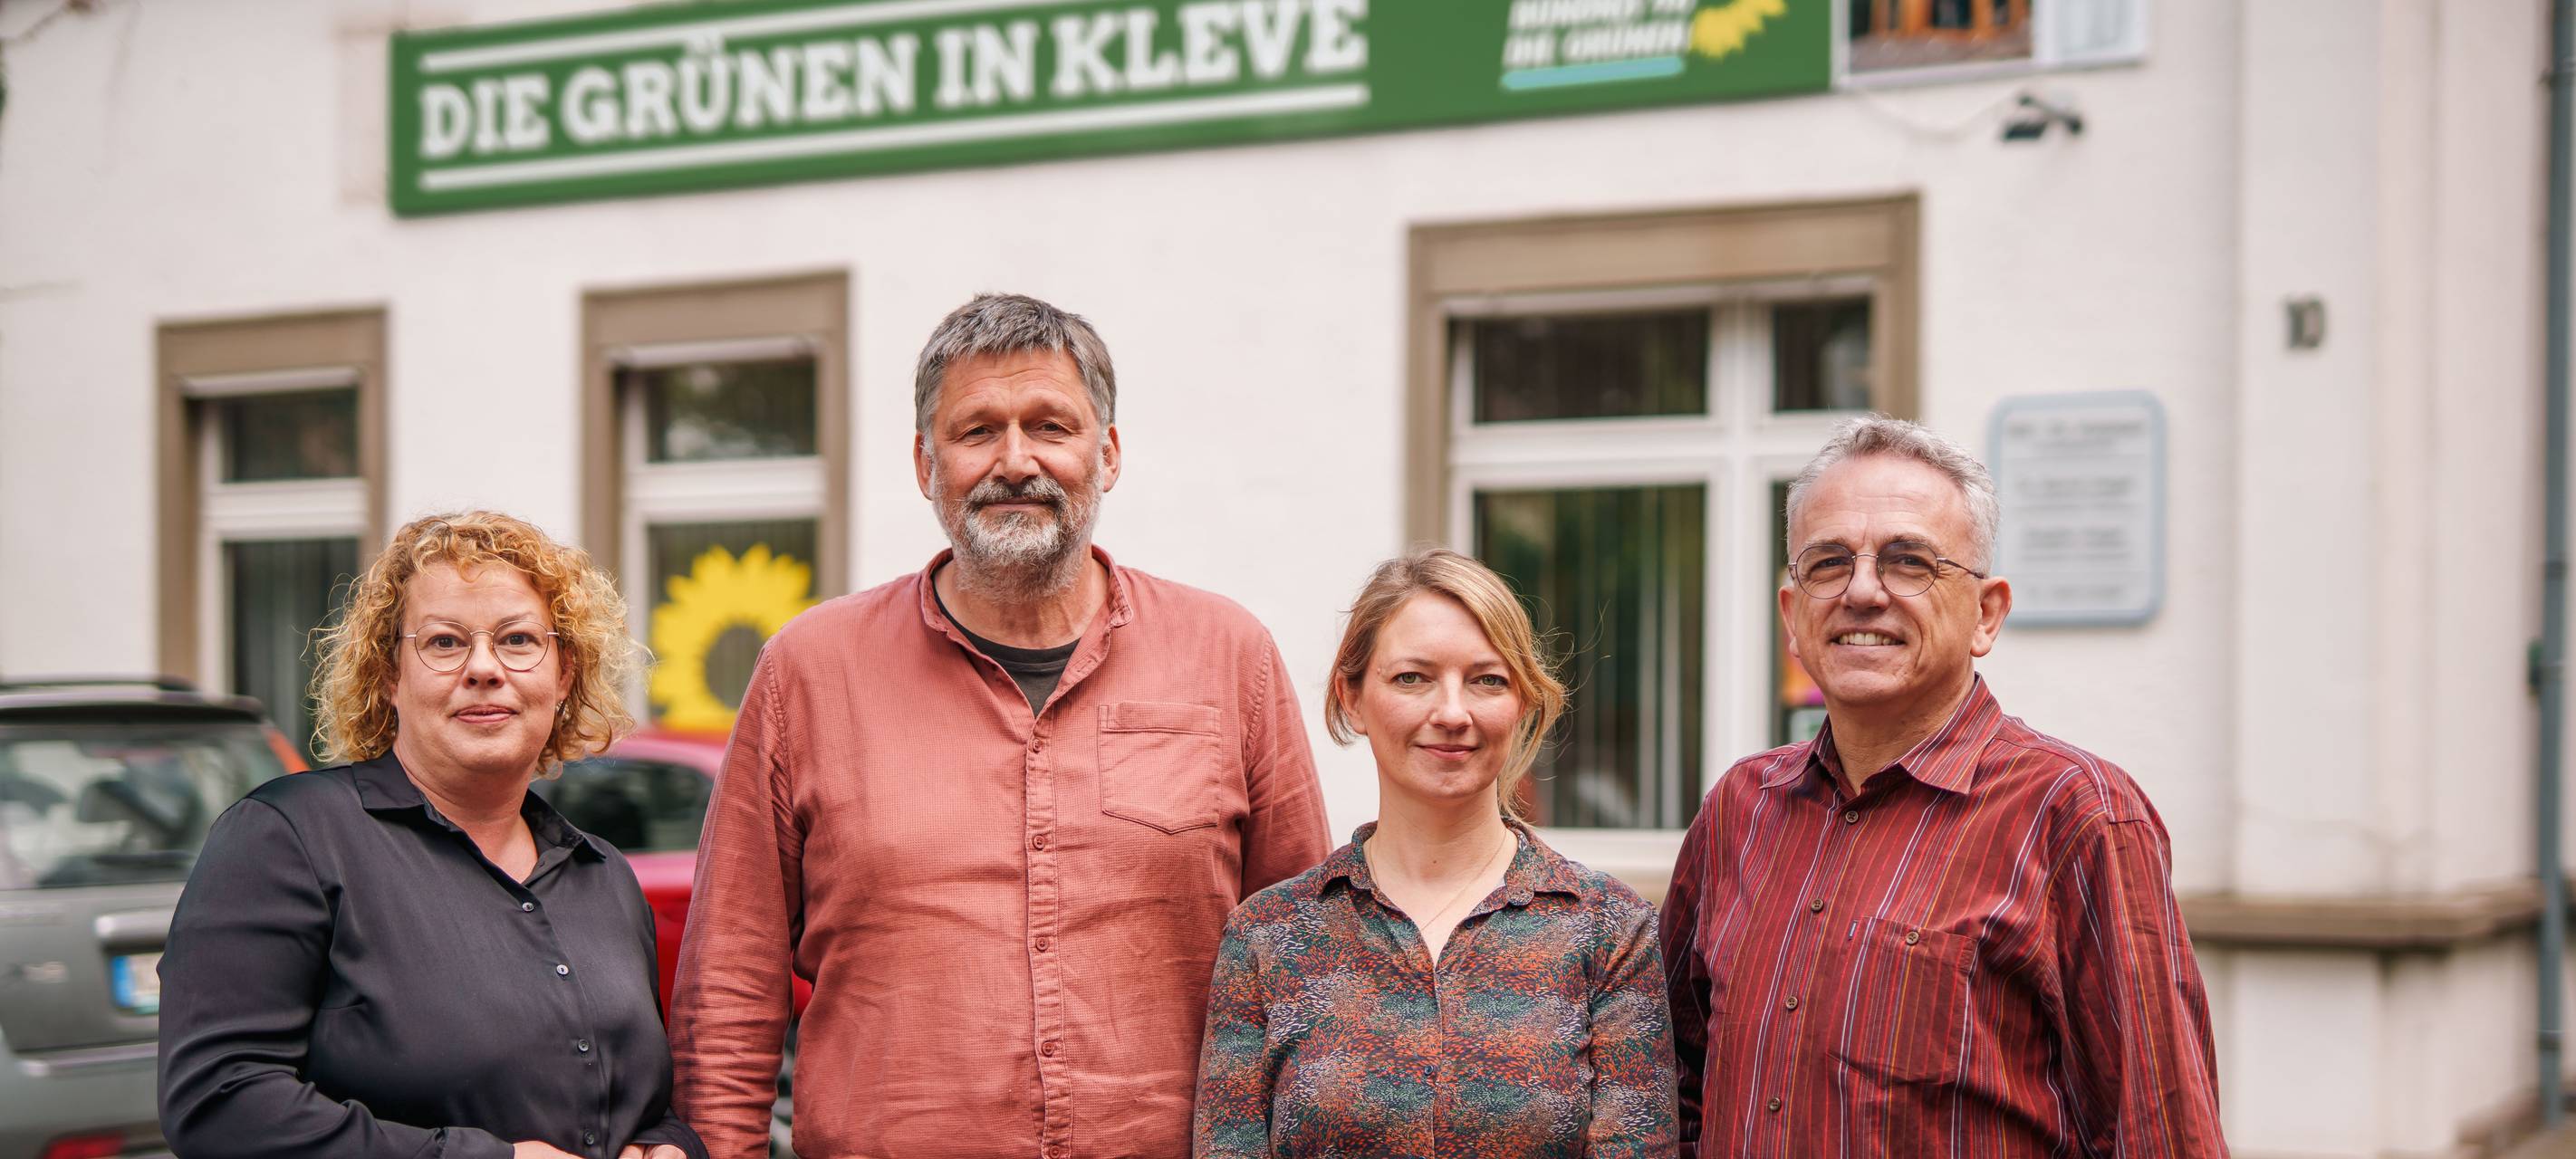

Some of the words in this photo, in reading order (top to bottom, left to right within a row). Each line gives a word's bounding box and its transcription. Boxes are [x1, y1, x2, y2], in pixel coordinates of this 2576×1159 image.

[419, 73, 550, 159] DIE
[560, 29, 918, 143] GRÜNEN
[934, 20, 1039, 108] IN
[1051, 0, 1369, 98] KLEVE
